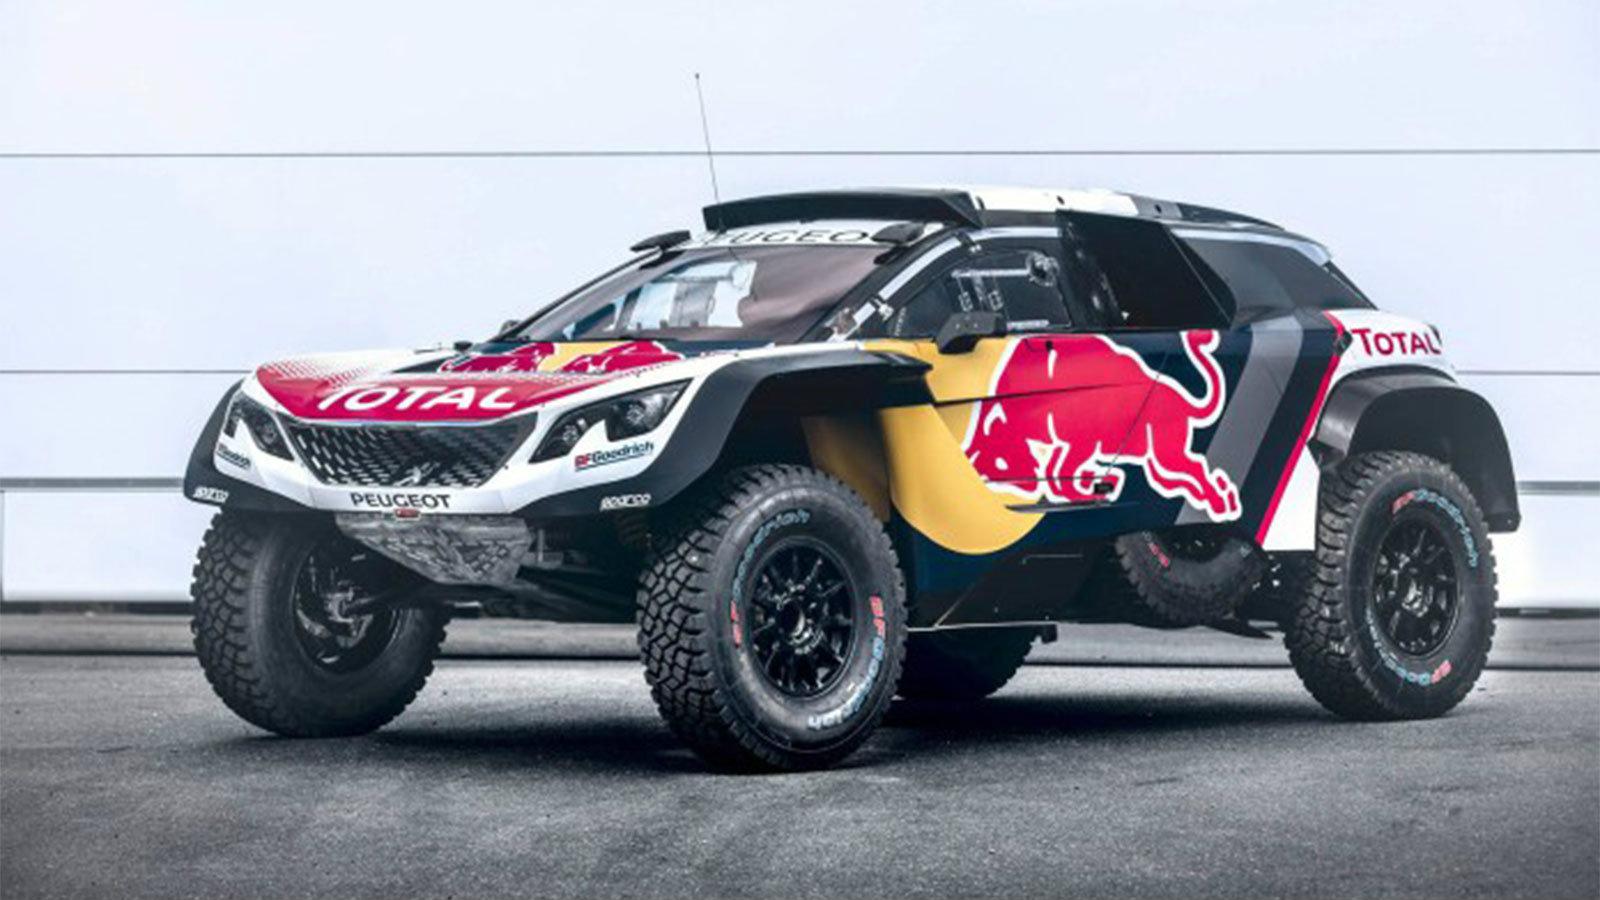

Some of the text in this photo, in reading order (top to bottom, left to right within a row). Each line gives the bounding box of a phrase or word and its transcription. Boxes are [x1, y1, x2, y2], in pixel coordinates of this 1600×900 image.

[1351, 328, 1441, 356] TOTAL
[318, 386, 515, 411] TOTAL
[575, 442, 654, 466] BFGoodrich
[350, 492, 450, 508] PEUGEOT
